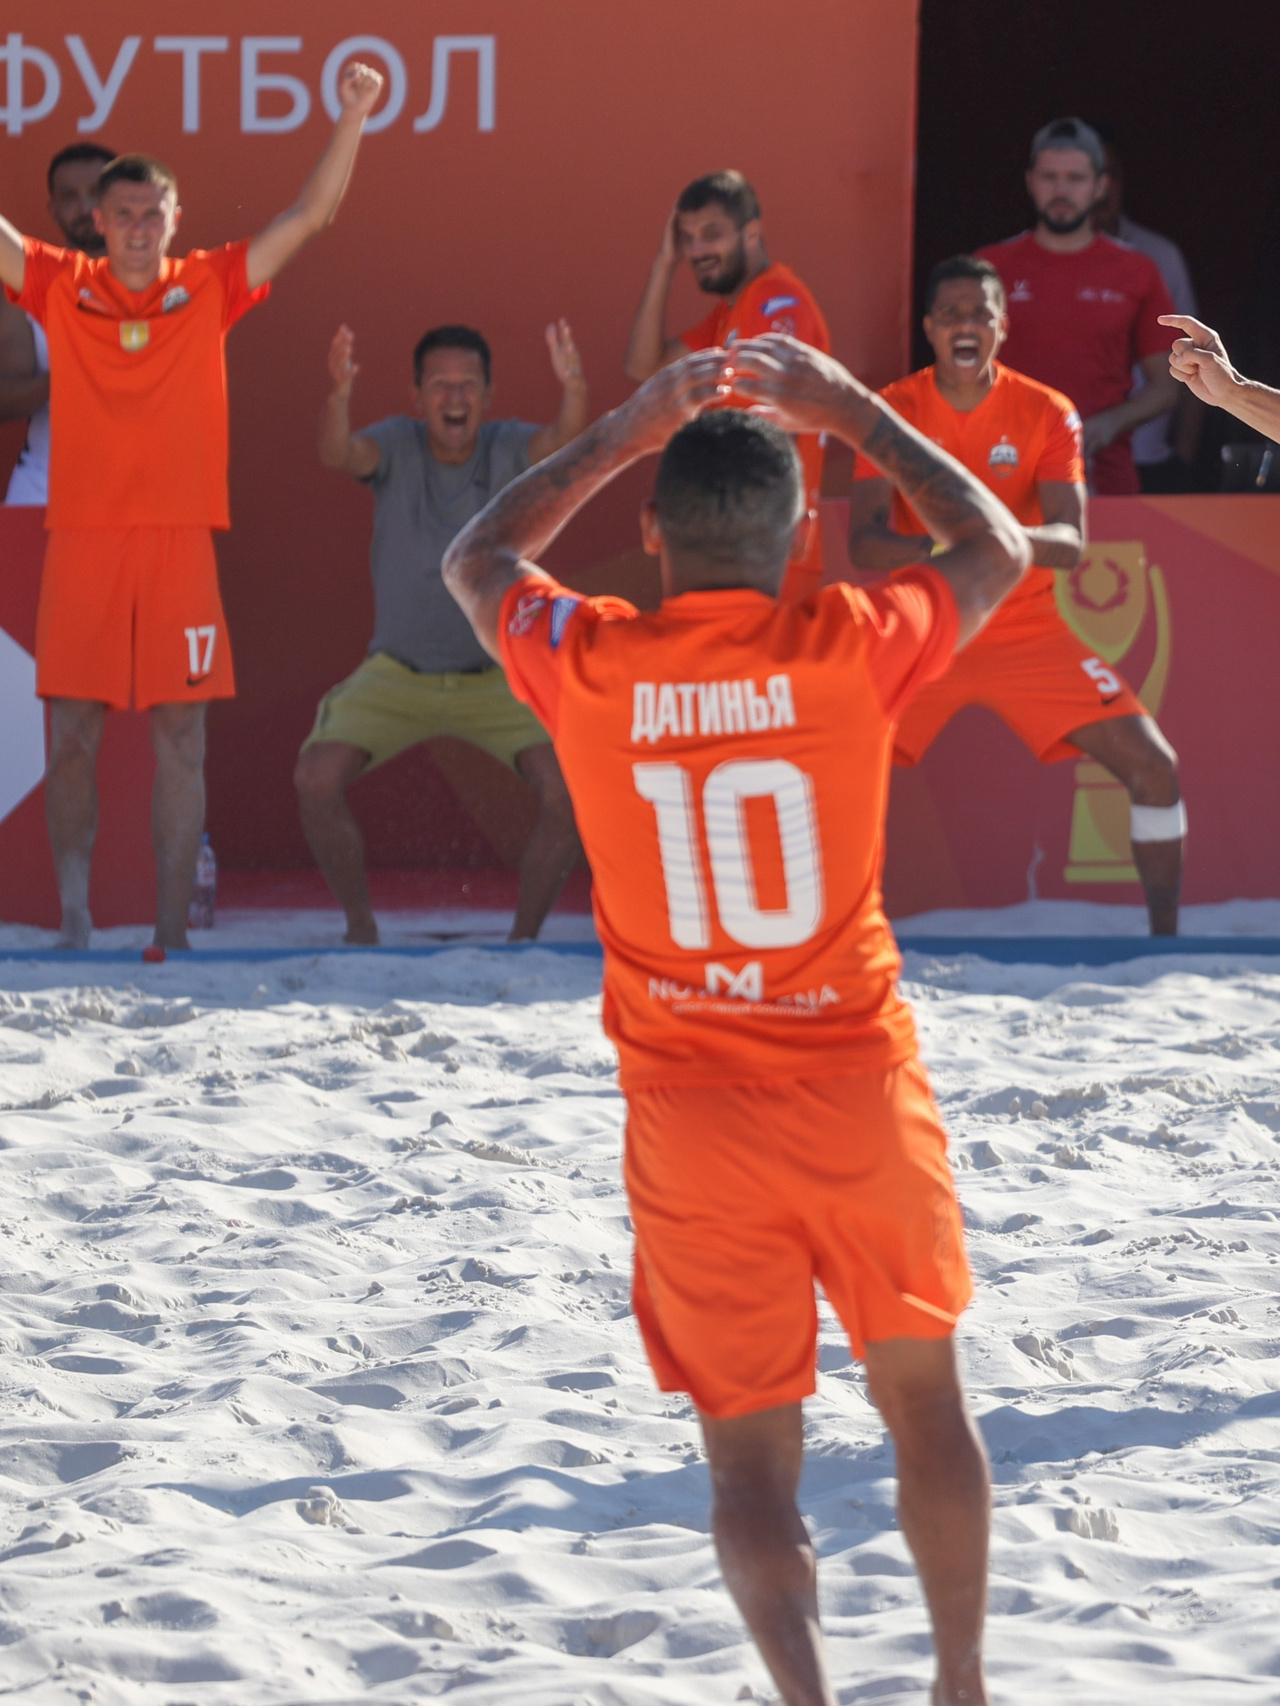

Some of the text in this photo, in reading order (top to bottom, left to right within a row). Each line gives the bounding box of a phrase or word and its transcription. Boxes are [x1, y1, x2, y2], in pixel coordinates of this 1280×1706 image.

[0, 33, 495, 136] ФУТБОЛ
[184, 624, 216, 675] 17
[1080, 656, 1120, 693] 5
[631, 673, 796, 744] ДАТИНЬЯ
[632, 757, 824, 950] 10
